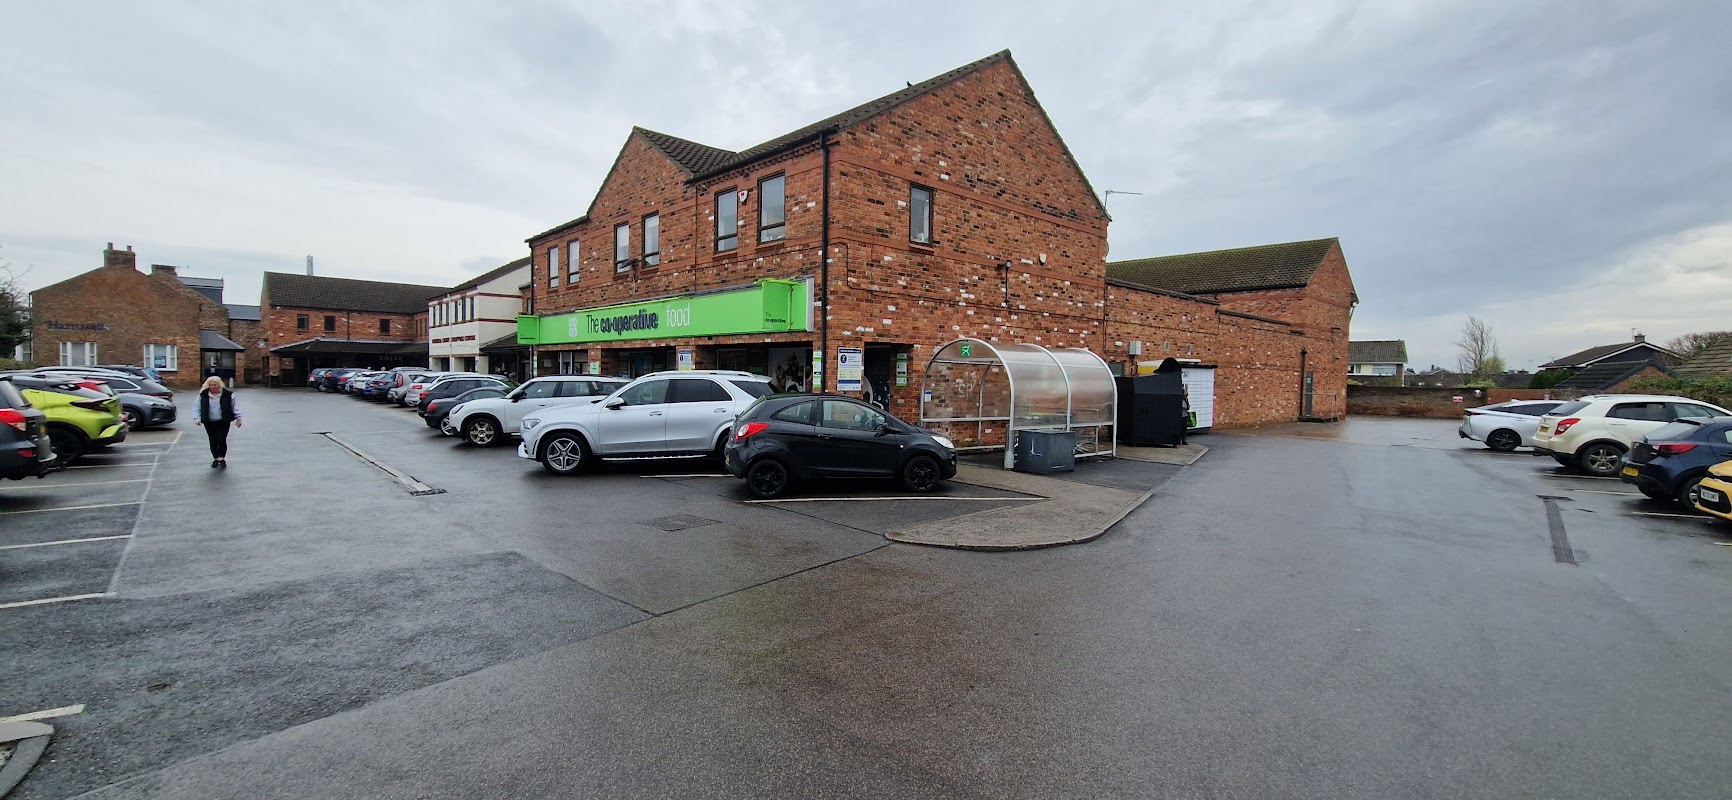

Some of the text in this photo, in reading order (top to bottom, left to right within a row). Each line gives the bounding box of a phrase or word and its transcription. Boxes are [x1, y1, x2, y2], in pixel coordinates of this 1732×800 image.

[586, 302, 691, 336] The co-operative food
